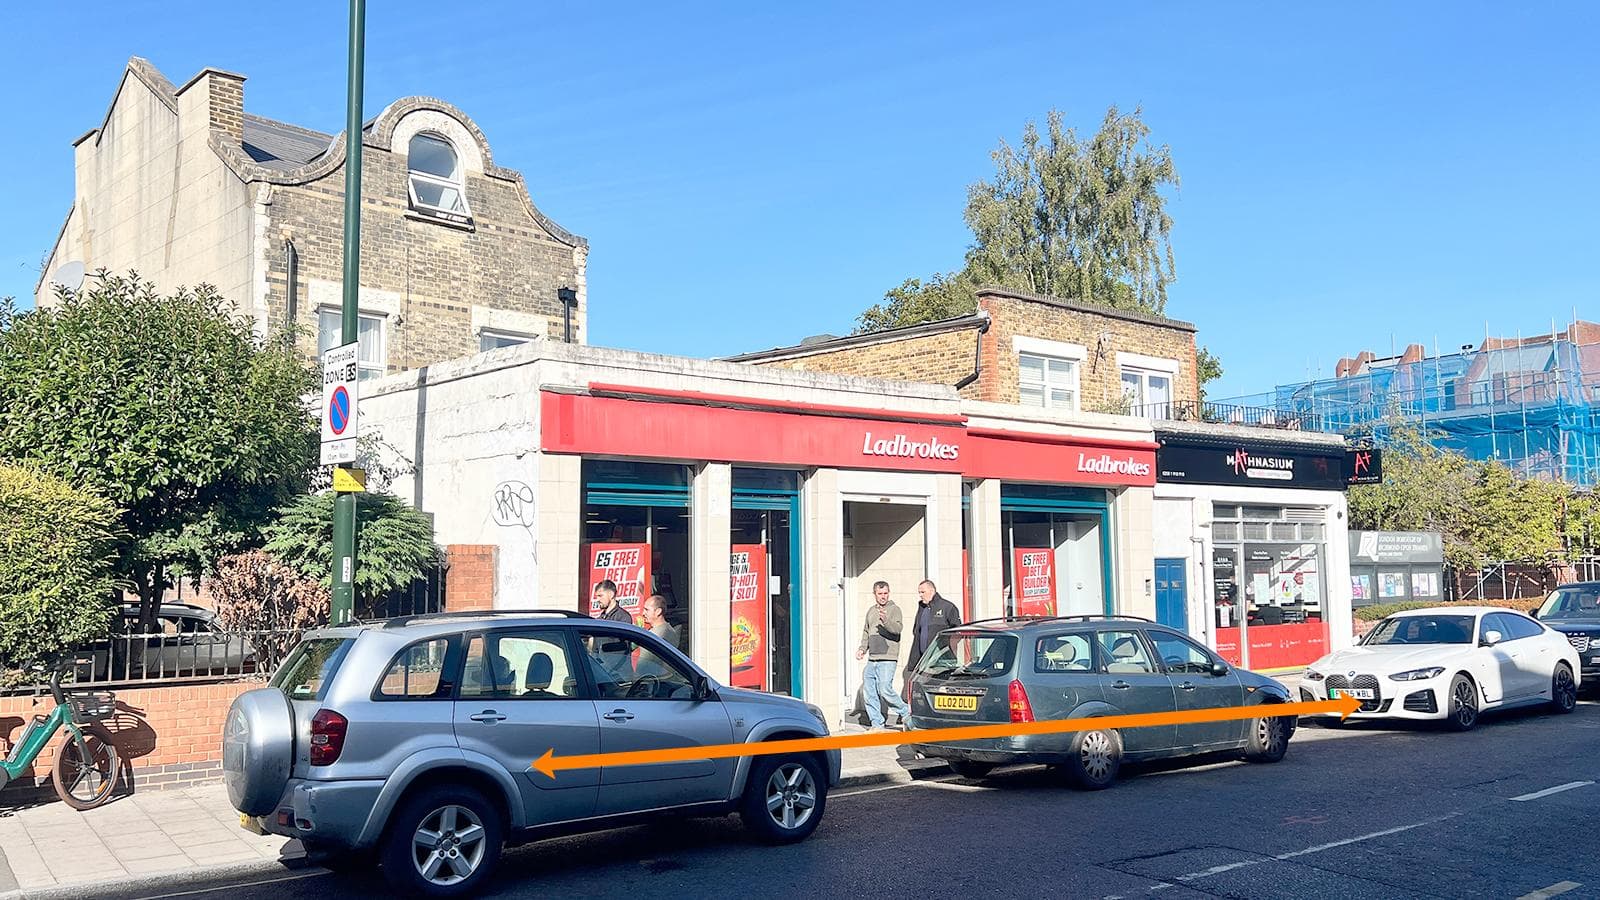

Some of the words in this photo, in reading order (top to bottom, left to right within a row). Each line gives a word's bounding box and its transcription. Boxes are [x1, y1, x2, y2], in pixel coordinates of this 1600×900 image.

[328, 349, 354, 365] Controlled
[325, 368, 344, 385] ZONE
[862, 431, 960, 460] Ladbrokes
[1077, 452, 1150, 476] Ladbrokes
[596, 552, 611, 567] £5
[613, 550, 638, 566] FREE
[1024, 554, 1031, 565] £5
[1033, 553, 1047, 565] FREE
[606, 567, 626, 582] BET
[741, 564, 749, 575] IN
[1030, 566, 1041, 576] BET
[731, 574, 756, 588] D-HOT
[736, 586, 756, 600] SLOT
[938, 697, 957, 708] LL02
[958, 697, 974, 709] DLU
